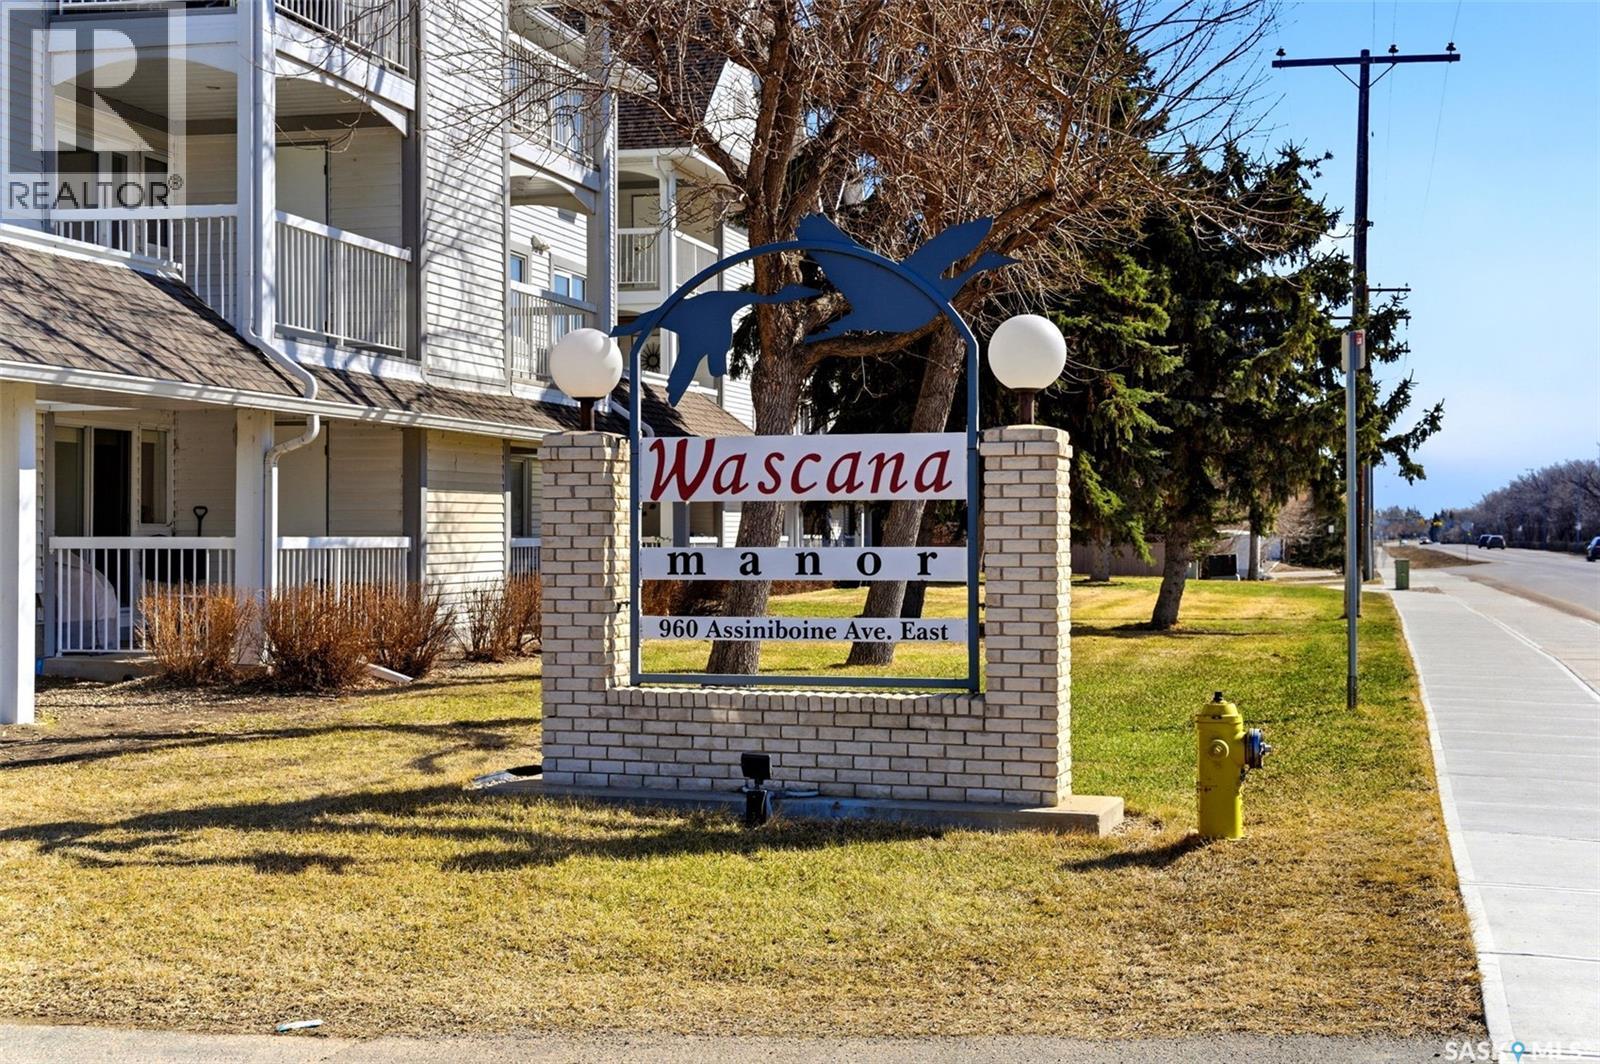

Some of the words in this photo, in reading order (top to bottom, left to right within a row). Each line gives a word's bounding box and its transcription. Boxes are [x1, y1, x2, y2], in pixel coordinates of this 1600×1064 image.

[649, 438, 953, 501] Wascana
[667, 551, 938, 576] manor
[659, 619, 699, 639] 960
[705, 619, 837, 641] Assiniboine
[844, 621, 892, 641] Ave.
[900, 621, 949, 641] East
